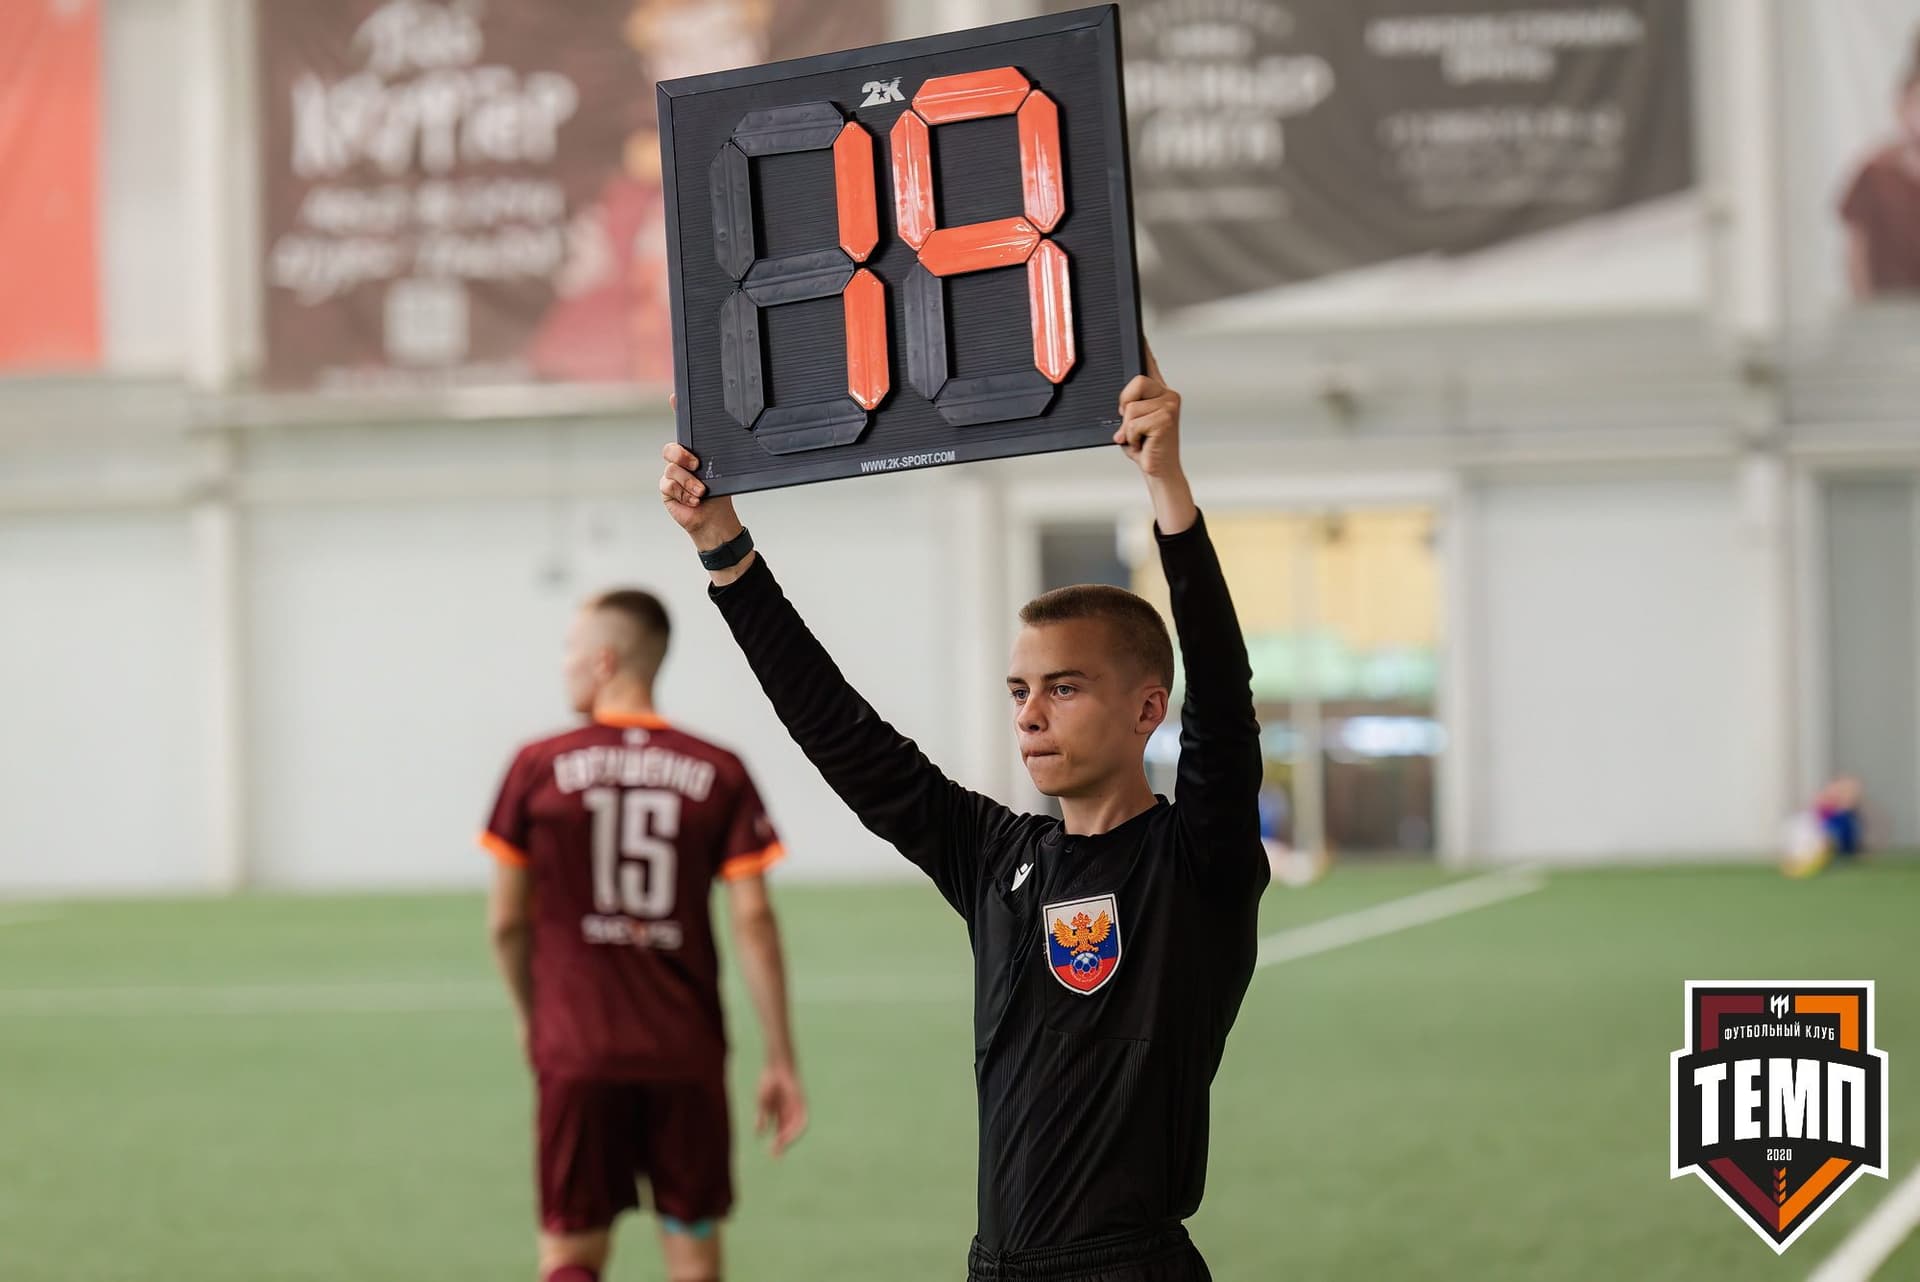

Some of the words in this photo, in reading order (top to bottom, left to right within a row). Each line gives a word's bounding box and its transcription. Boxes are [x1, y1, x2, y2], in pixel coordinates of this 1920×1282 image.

[859, 76, 906, 108] 2K
[833, 66, 1076, 411] 19
[860, 450, 956, 473] WWW.2K-SPORT.COM
[582, 786, 682, 919] 15
